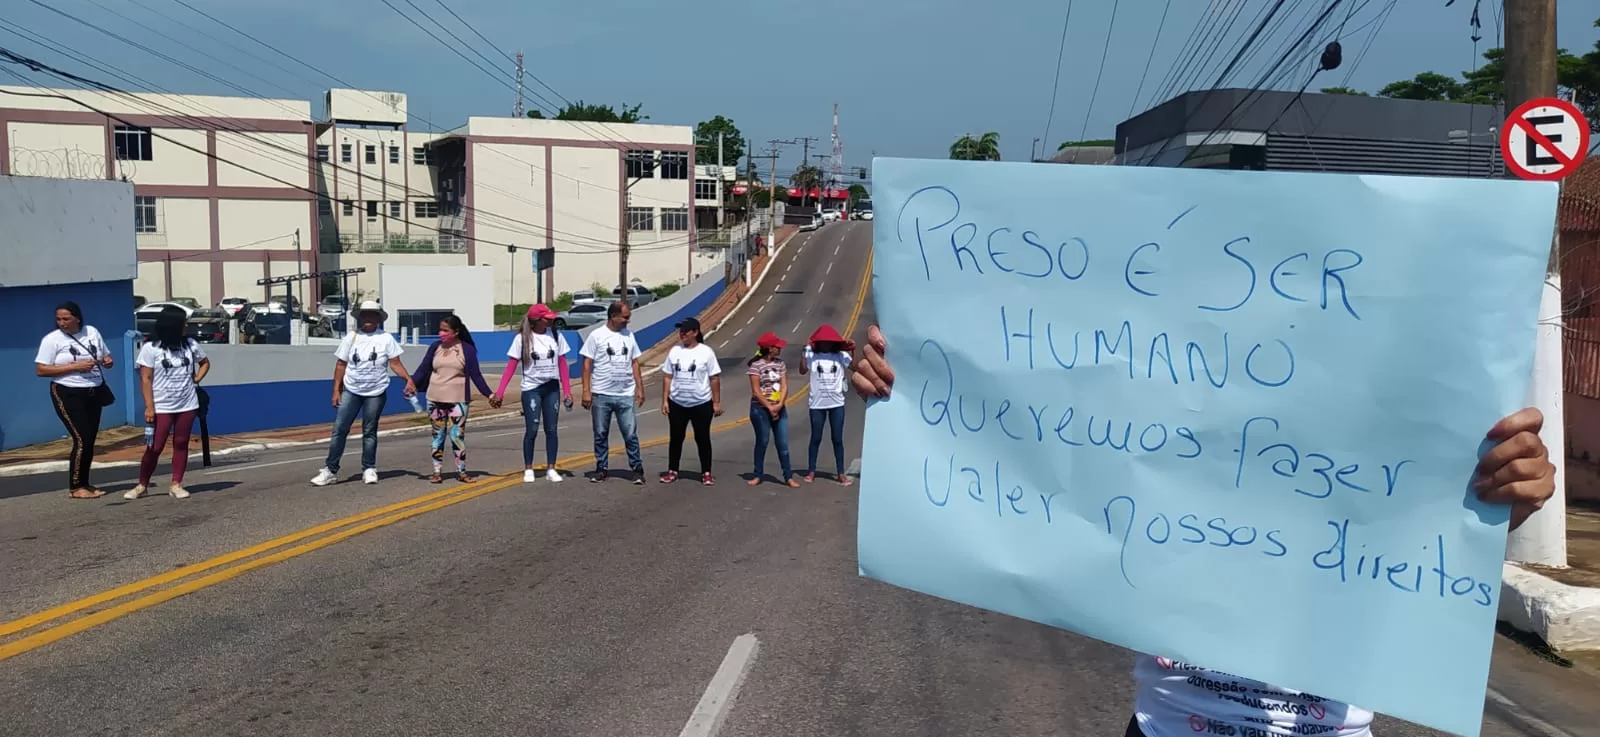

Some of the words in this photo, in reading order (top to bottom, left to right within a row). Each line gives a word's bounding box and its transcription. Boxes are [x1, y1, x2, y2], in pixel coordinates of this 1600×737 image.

[897, 185, 1090, 282] PRESO
[1124, 204, 1199, 297] É
[1197, 236, 1363, 321] SER
[1000, 304, 1296, 389] HUMANO
[918, 338, 1202, 459] Queremos
[1232, 416, 1417, 499] fazer
[1311, 518, 1493, 607] direitos
